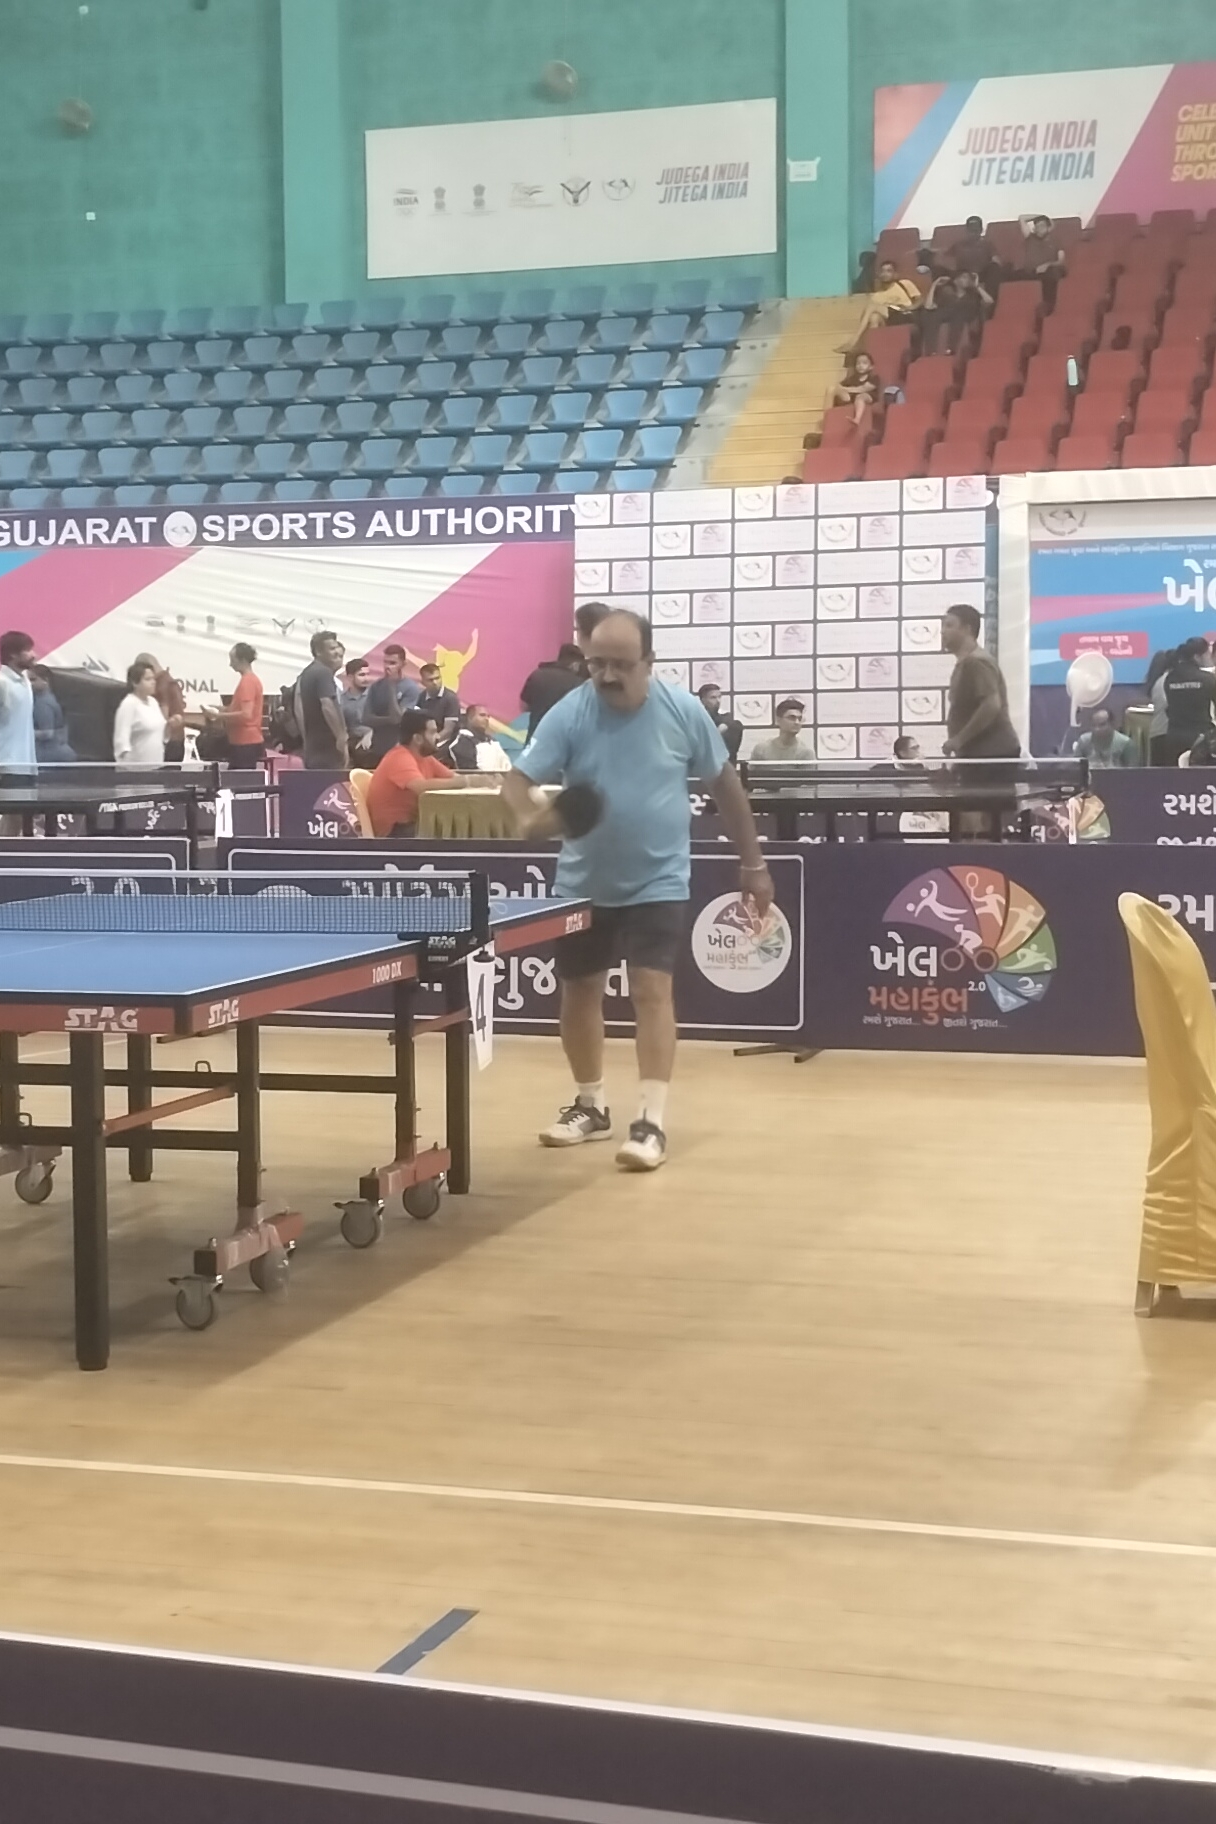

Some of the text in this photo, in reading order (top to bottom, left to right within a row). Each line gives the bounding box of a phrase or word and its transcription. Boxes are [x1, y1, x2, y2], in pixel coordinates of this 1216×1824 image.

[958, 119, 1097, 156] JUDEGA INDIA
[655, 162, 749, 186] JUDEGA INDIA
[962, 150, 1096, 186] JITEGA INDIA
[658, 180, 748, 204] JITEGA INDIA
[202, 510, 356, 541] SPORTS
[365, 504, 576, 538] AUTHORIT
[869, 931, 939, 978] ખેલ
[372, 960, 402, 984] 1000 DX
[967, 981, 987, 992] 2.0
[64, 1006, 139, 1032] STAG
[208, 999, 240, 1029] STAG
